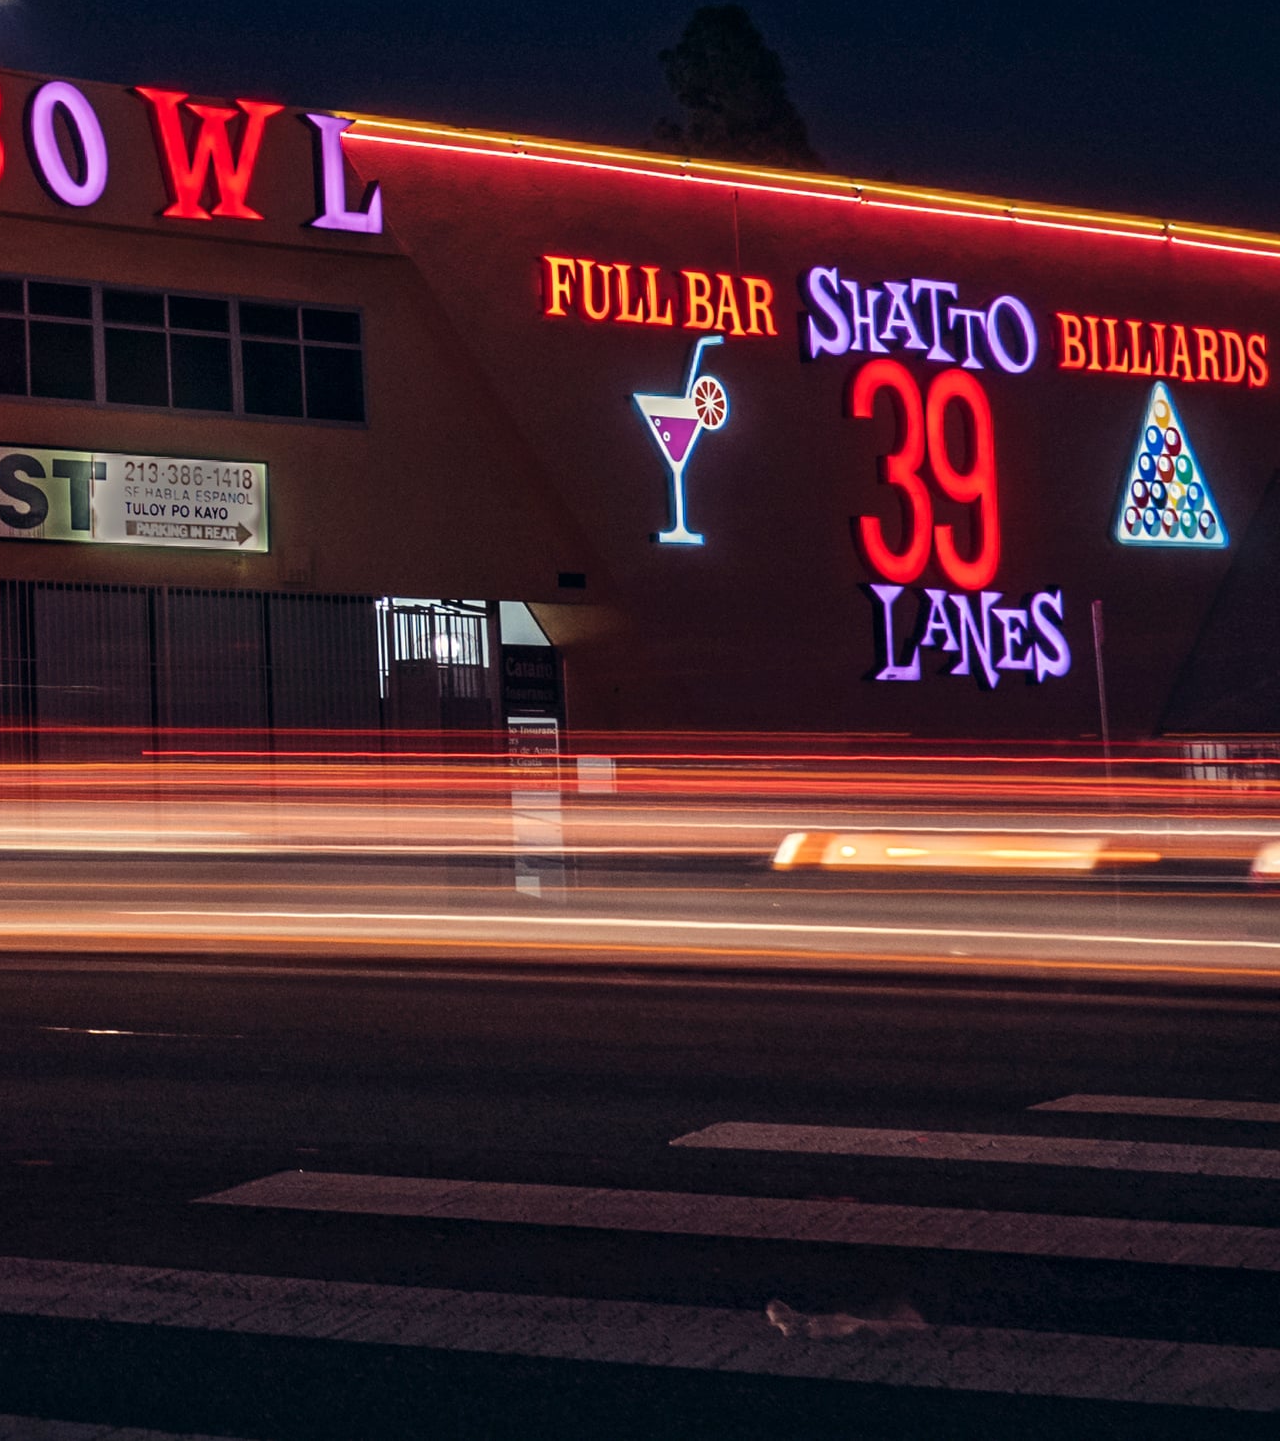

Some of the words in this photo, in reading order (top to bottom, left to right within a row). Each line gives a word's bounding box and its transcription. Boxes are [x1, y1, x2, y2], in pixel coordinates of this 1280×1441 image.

[542, 255, 674, 327] FULL
[681, 269, 778, 337] BAR
[806, 265, 1037, 374] SHATTO
[1056, 311, 1270, 389] BILLIARDS
[125, 502, 166, 516] TULOY
[172, 505, 190, 518] PO
[194, 506, 228, 520] KAYO
[145, 487, 190, 502] HABLA
[851, 358, 1000, 591] 39
[136, 521, 188, 538] PARKING
[190, 527, 202, 538] IN
[205, 528, 237, 540] REAR
[869, 583, 1073, 690] LANES
